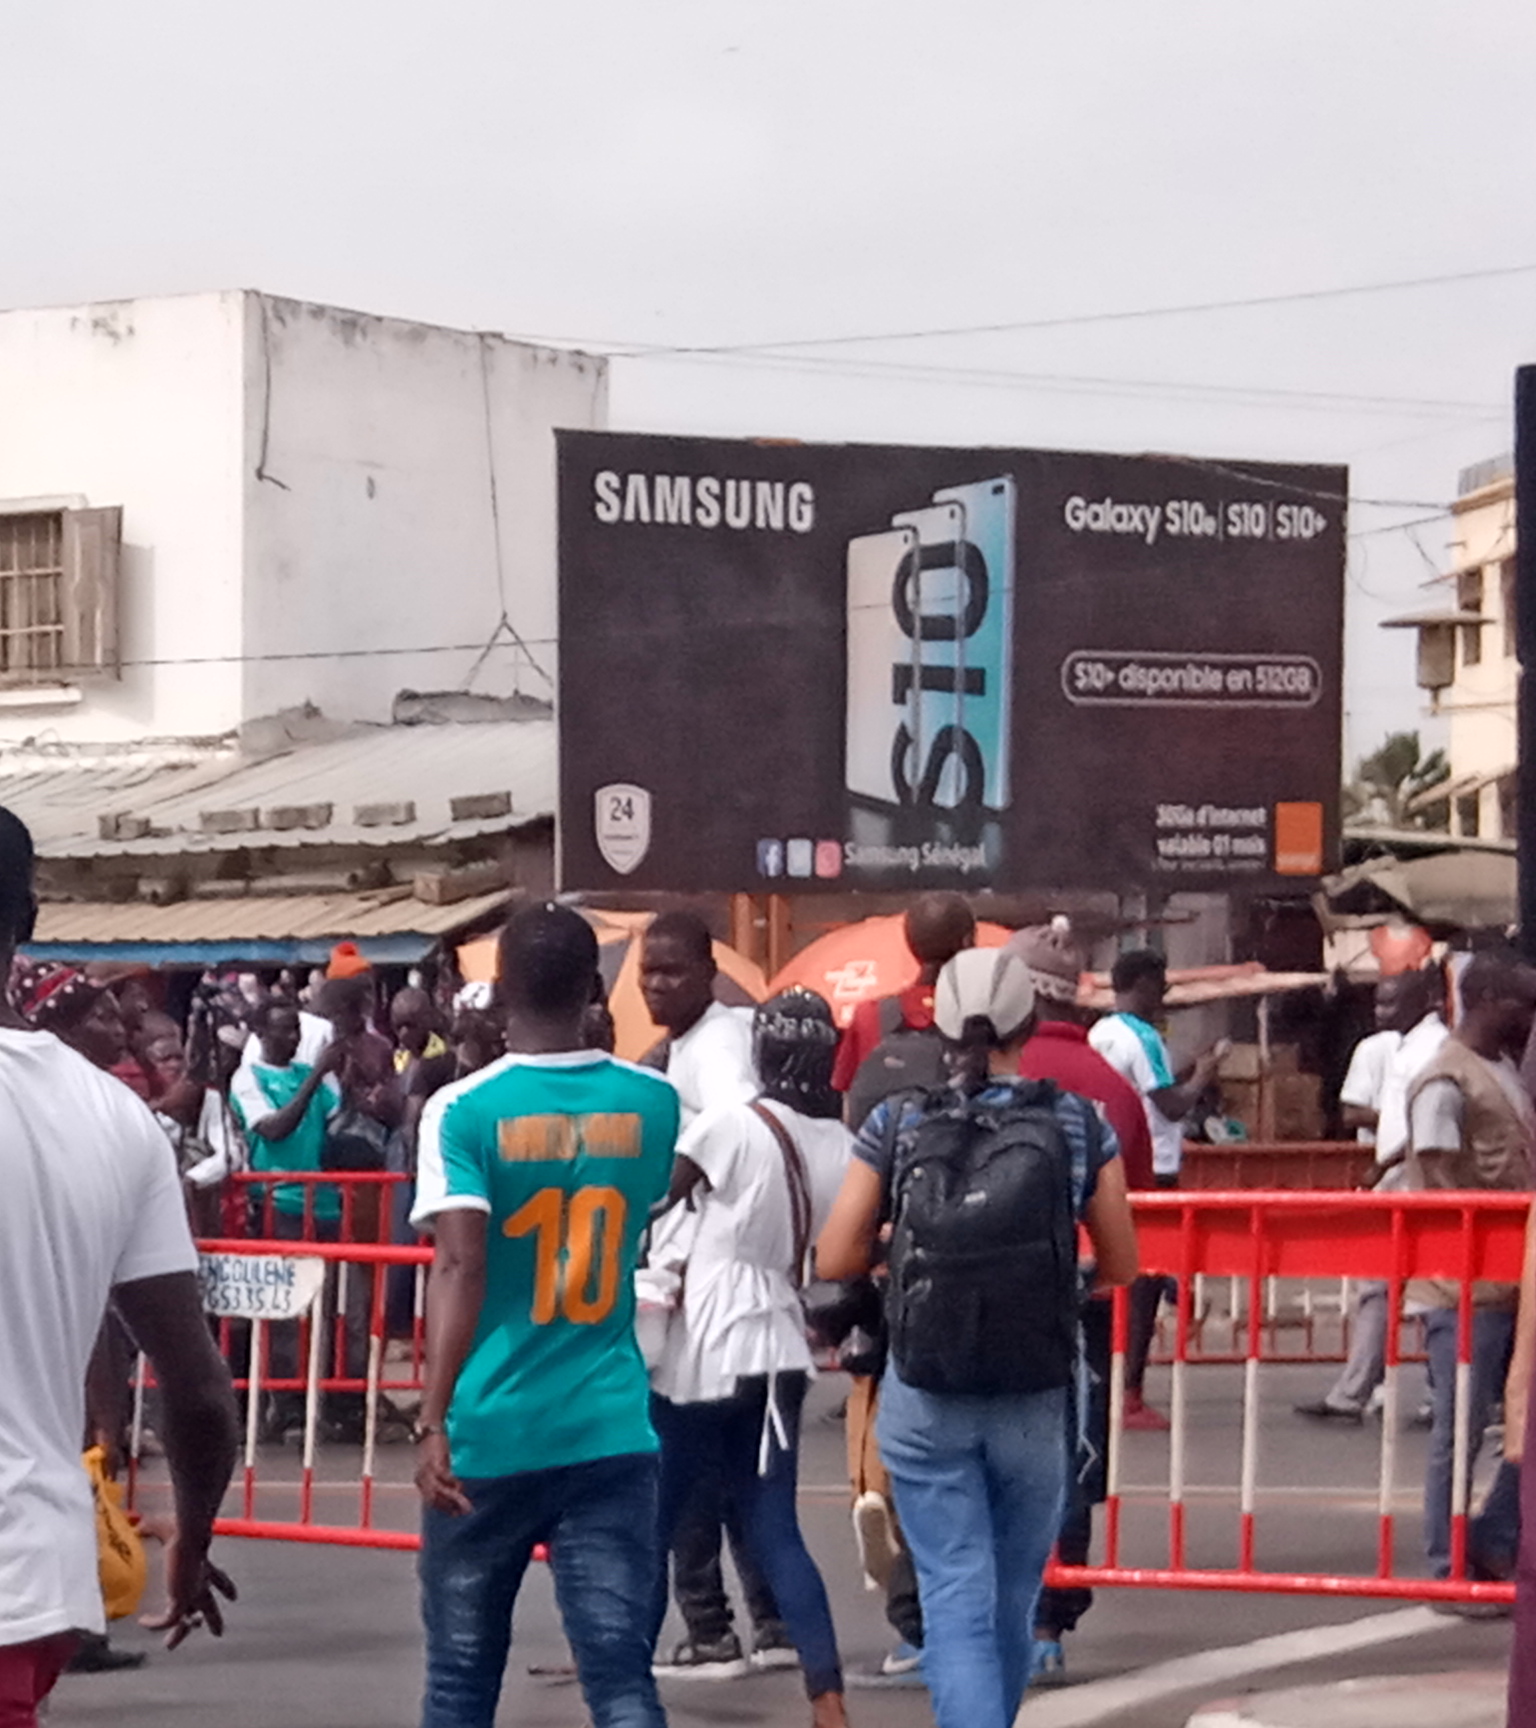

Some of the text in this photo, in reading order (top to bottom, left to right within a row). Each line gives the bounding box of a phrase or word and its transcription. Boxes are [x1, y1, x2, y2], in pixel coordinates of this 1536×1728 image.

[594, 470, 815, 533] SAMSUNG
[1064, 496, 1161, 545] Galaxy
[890, 539, 989, 811] S10
[1118, 663, 1223, 697] disponible
[1226, 669, 1252, 692] en
[610, 796, 634, 822] 24
[502, 1185, 627, 1325] 10
